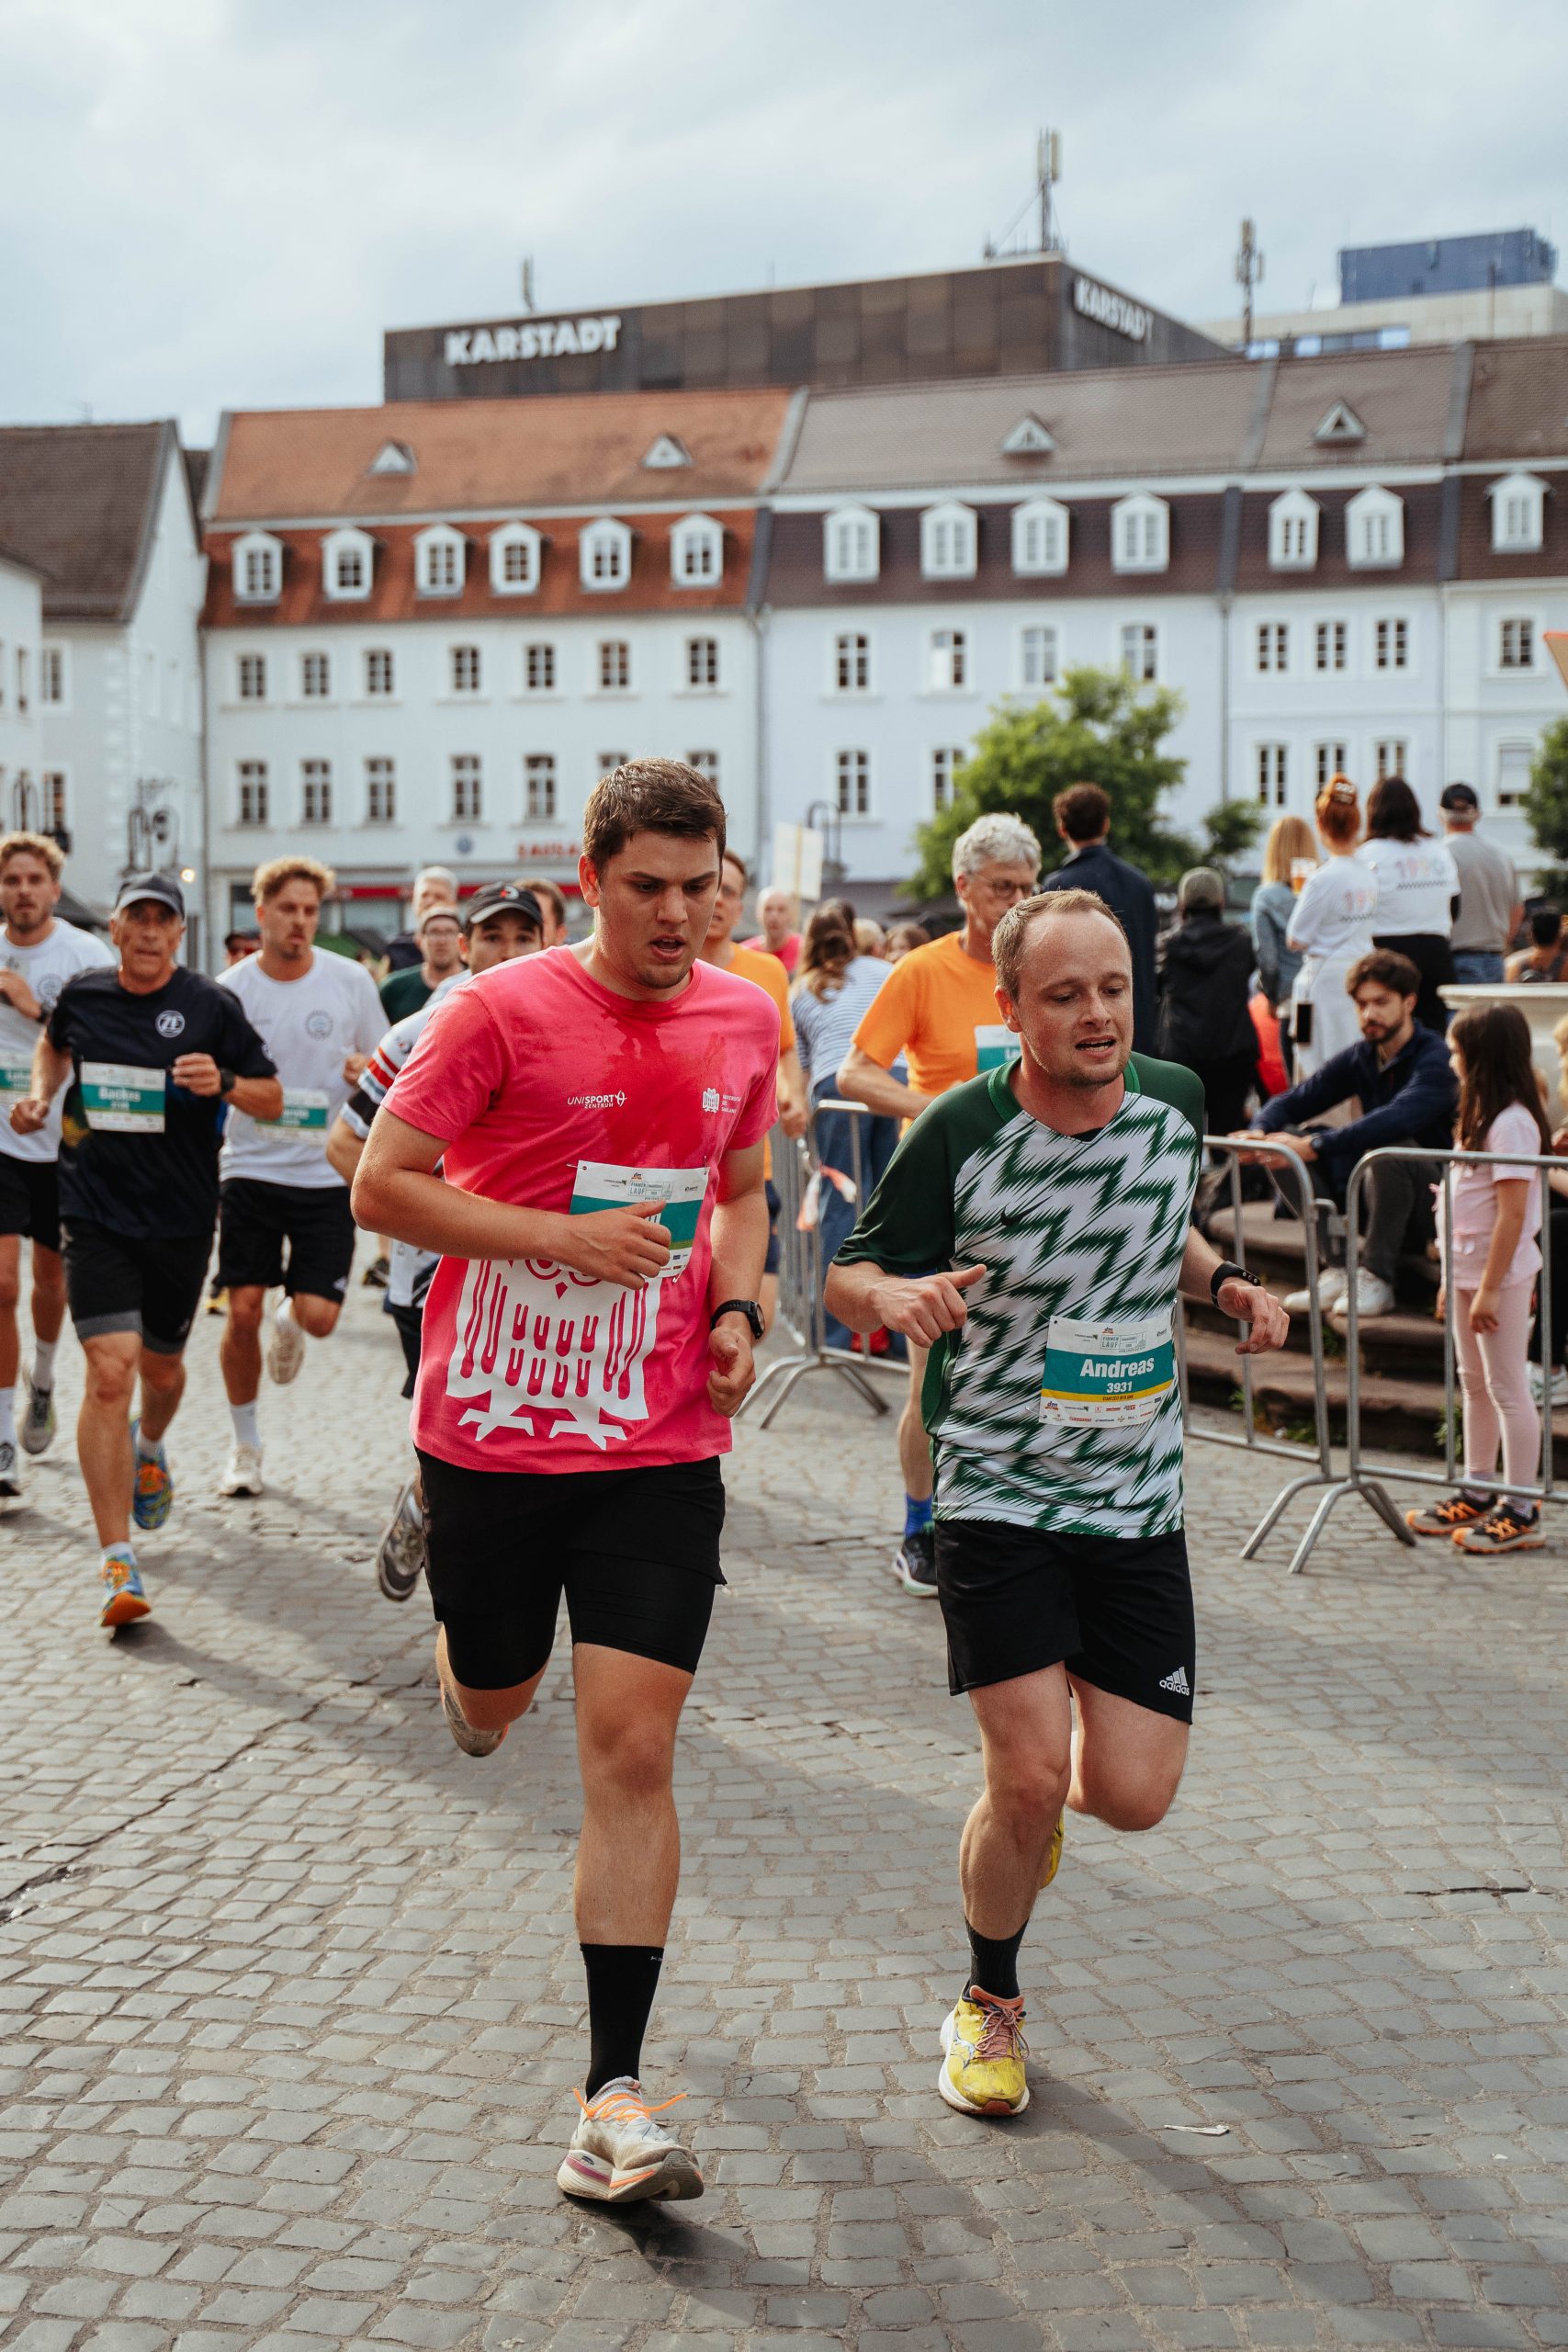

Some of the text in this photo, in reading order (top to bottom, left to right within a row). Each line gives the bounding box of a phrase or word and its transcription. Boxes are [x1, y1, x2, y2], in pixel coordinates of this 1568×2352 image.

[1073, 276, 1155, 345] KARSTADT
[445, 315, 622, 367] KARSTADT
[567, 1094, 615, 1105] UNISPORT
[1079, 1357, 1155, 1378] Andreas
[1106, 1381, 1133, 1394] 3931
[1159, 1679, 1190, 1696] adidas
